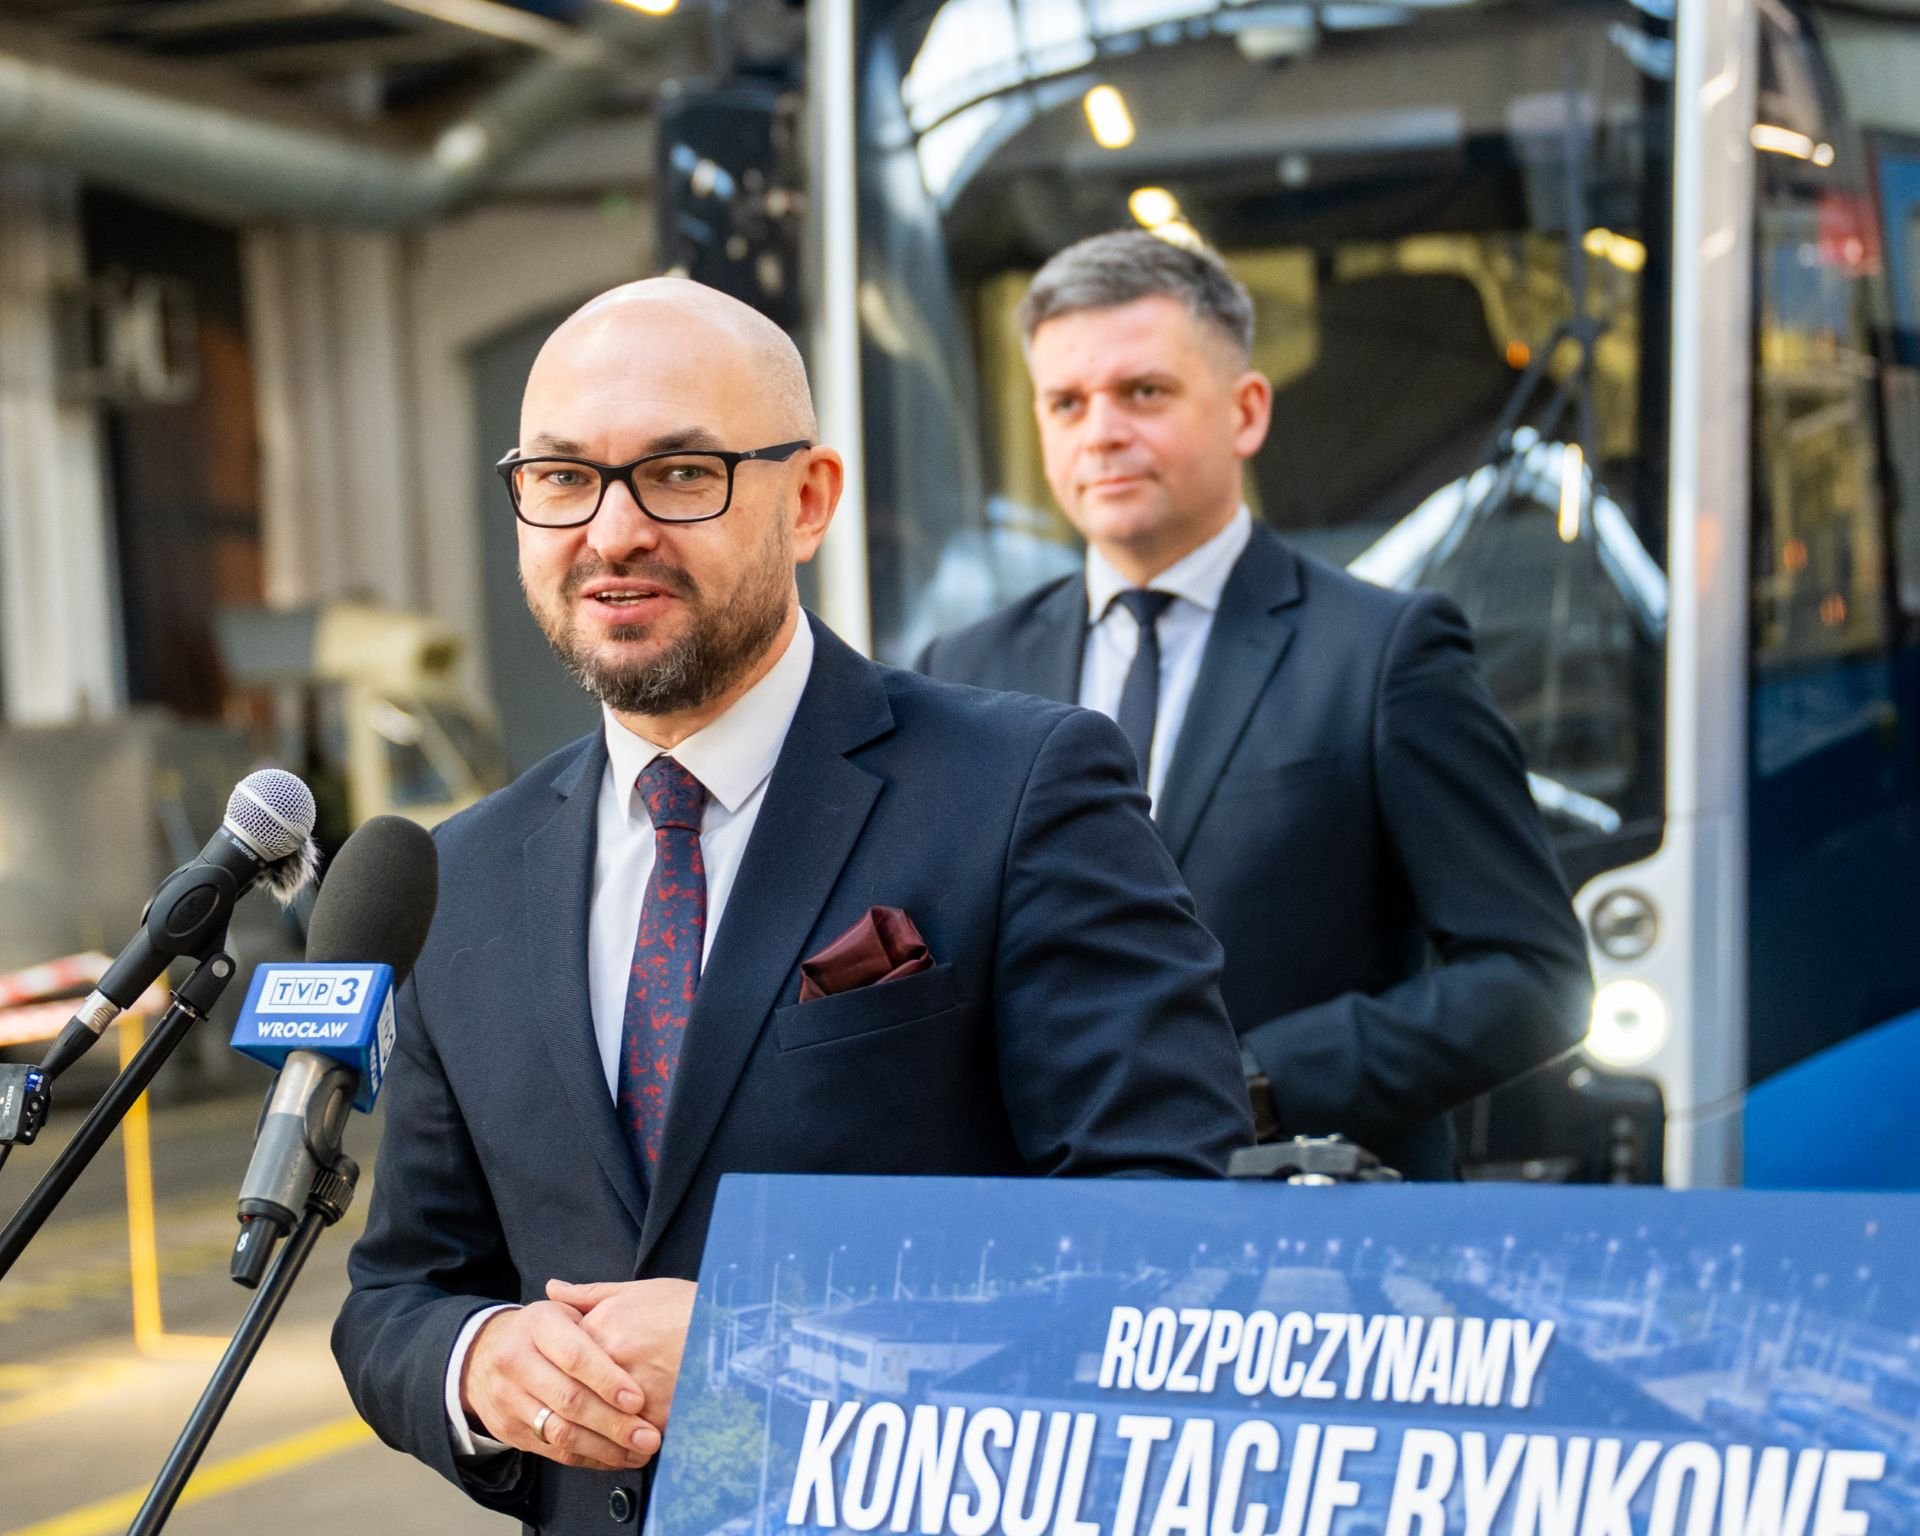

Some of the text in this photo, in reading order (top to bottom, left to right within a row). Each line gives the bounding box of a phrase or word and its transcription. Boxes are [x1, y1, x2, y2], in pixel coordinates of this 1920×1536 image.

[277, 977, 360, 1007] TVP 3
[258, 1021, 348, 1038] WROCŁAW
[237, 1231, 249, 1252] 8
[1098, 1306, 1556, 1408] ROZPOCZYNAMY
[786, 1399, 1887, 1536] KONSULTACJE RYNKOWE
